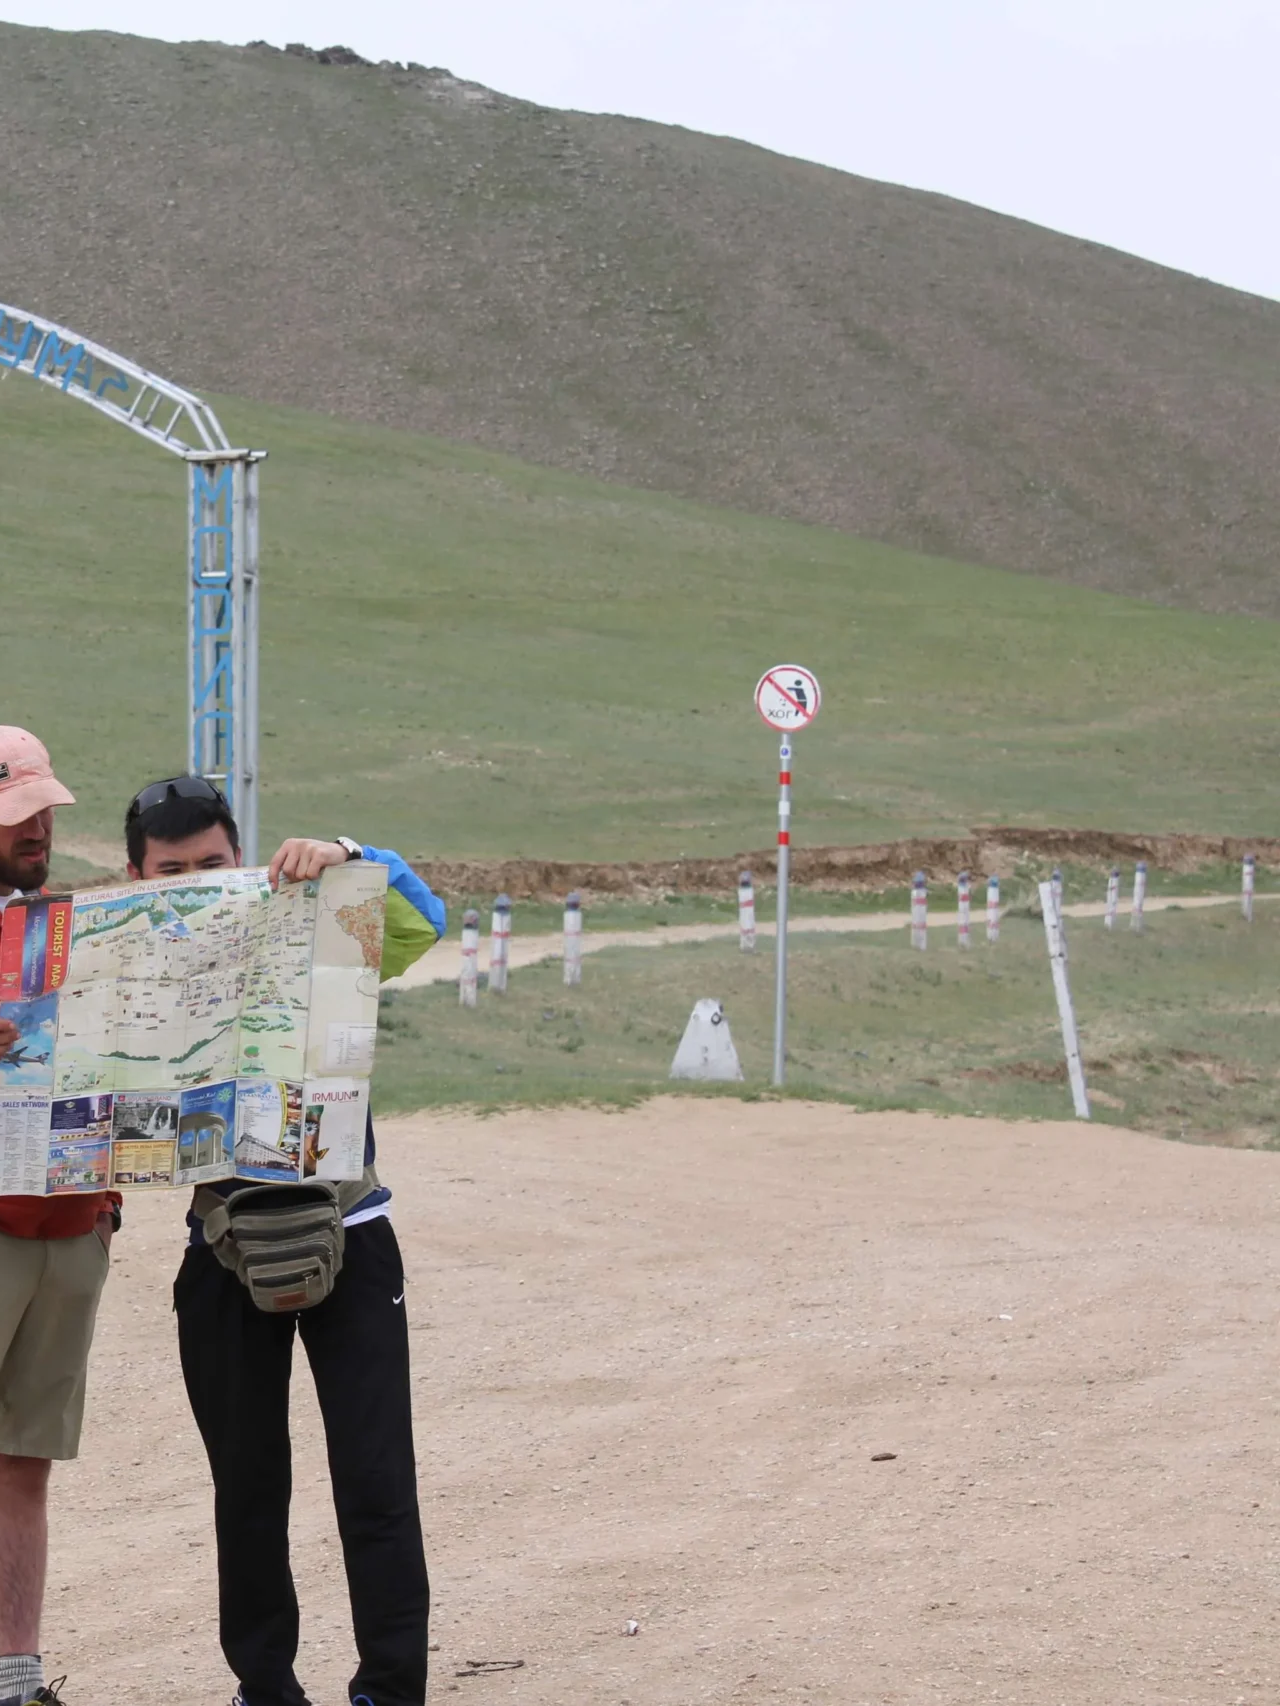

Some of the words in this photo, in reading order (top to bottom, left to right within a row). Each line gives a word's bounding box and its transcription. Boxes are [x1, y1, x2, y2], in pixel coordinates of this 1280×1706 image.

[768, 709, 794, 719] ХОГ
[75, 891, 114, 904] CULTURAL
[137, 885, 146, 893] IN
[147, 877, 202, 891] ULAANBAATAR
[52, 910, 65, 958] TOURIST
[51, 964, 61, 987] MAP
[312, 1091, 352, 1103] IRMUUN
